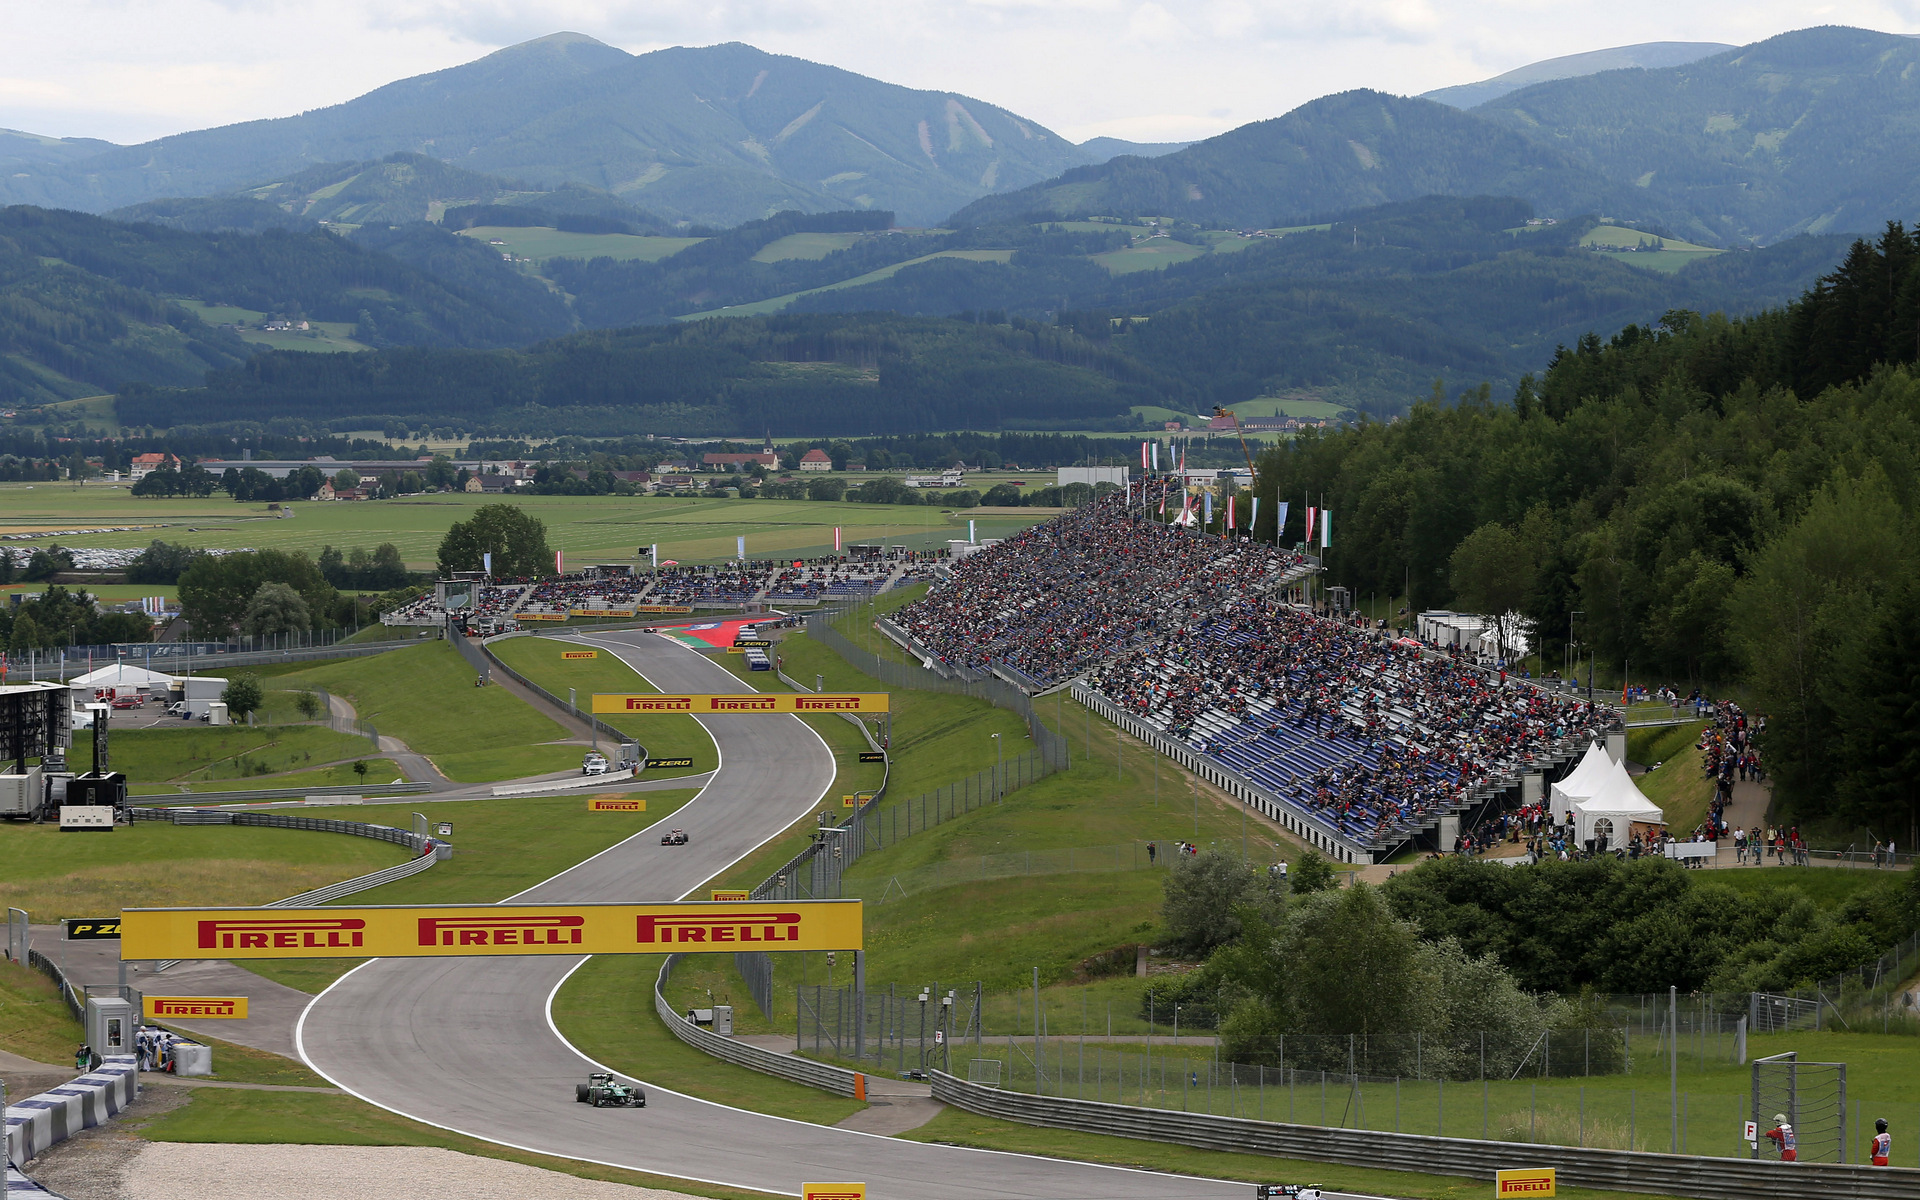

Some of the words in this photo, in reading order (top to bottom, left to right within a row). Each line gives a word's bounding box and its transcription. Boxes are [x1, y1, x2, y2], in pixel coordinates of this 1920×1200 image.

[626, 698, 691, 710] PIRELLI
[711, 698, 776, 709] PIRELLI
[796, 697, 860, 709] PIRELLI
[74, 925, 92, 934] P
[198, 919, 366, 948] PIRELLI
[418, 916, 584, 946] PIRELLI
[637, 913, 801, 943] PIRELLI
[154, 1000, 234, 1015] PIRELLI
[1747, 1125, 1754, 1136] F
[1502, 1178, 1550, 1192] PIRELLI
